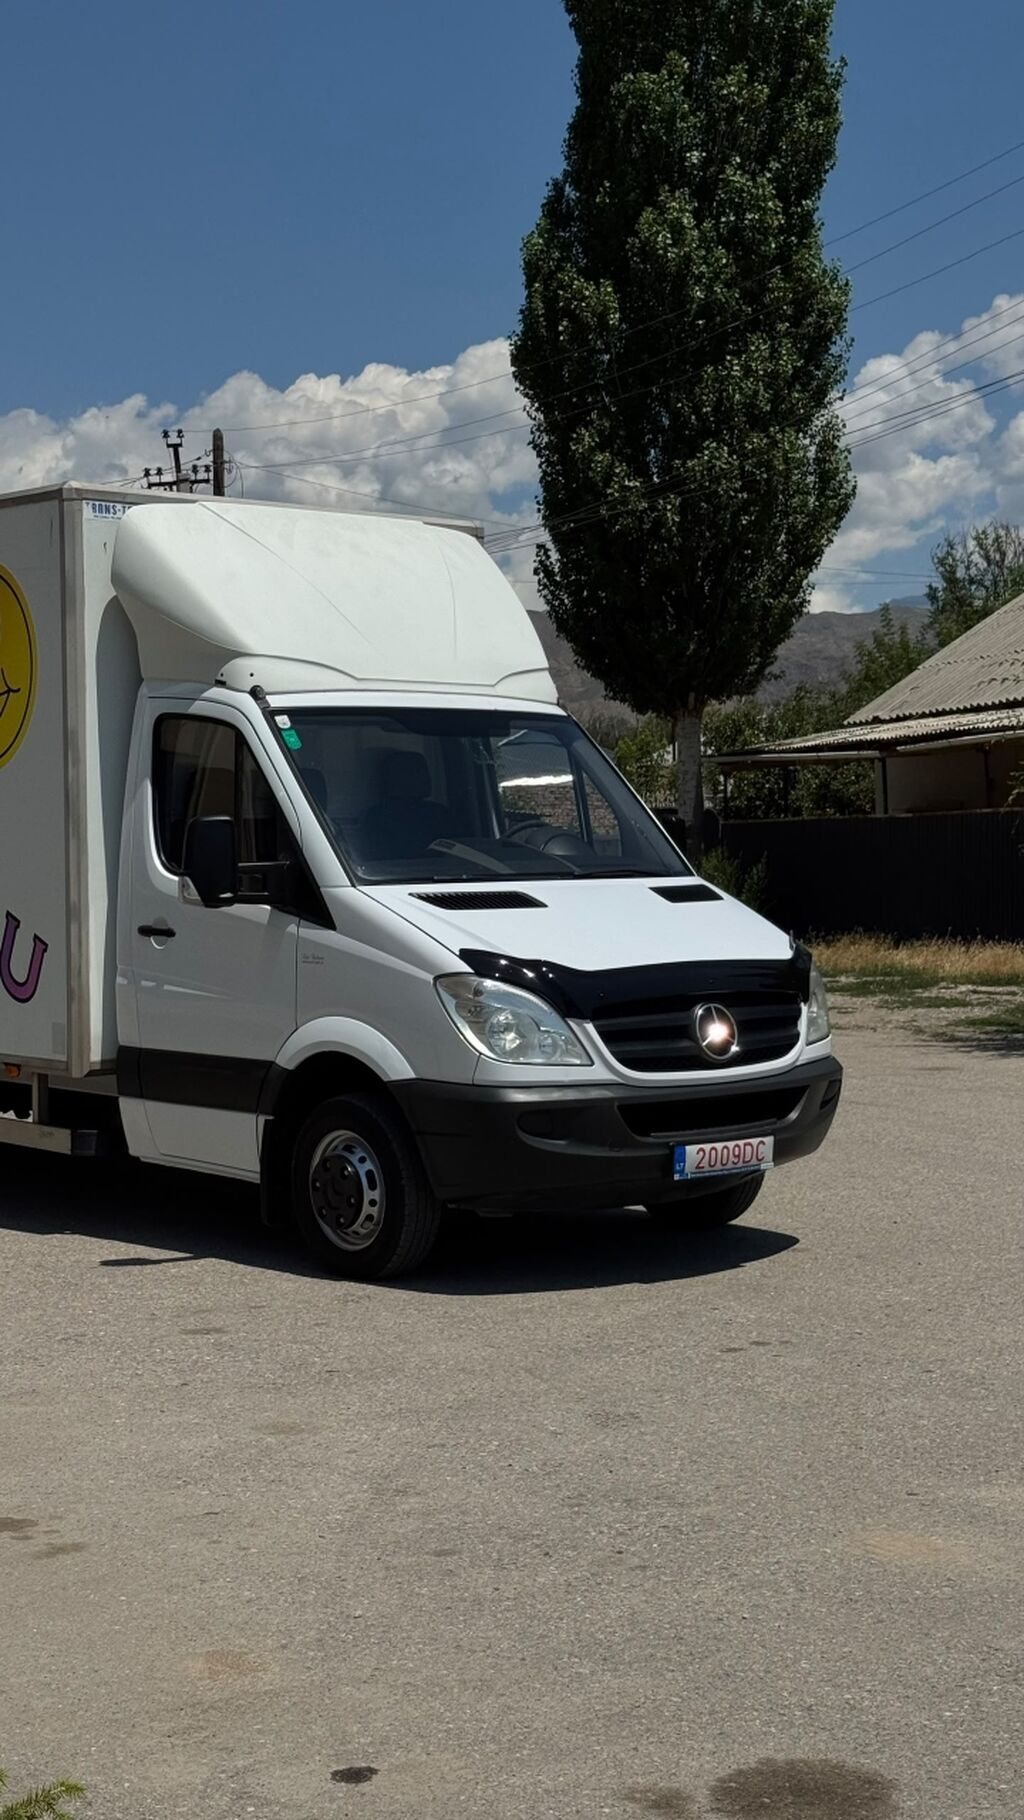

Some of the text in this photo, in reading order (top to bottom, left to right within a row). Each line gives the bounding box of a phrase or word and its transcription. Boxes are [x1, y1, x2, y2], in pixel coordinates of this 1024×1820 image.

[85, 501, 132, 516] TRANS-T
[694, 1140, 767, 1170] 2009DC
[676, 1162, 685, 1170] LT
